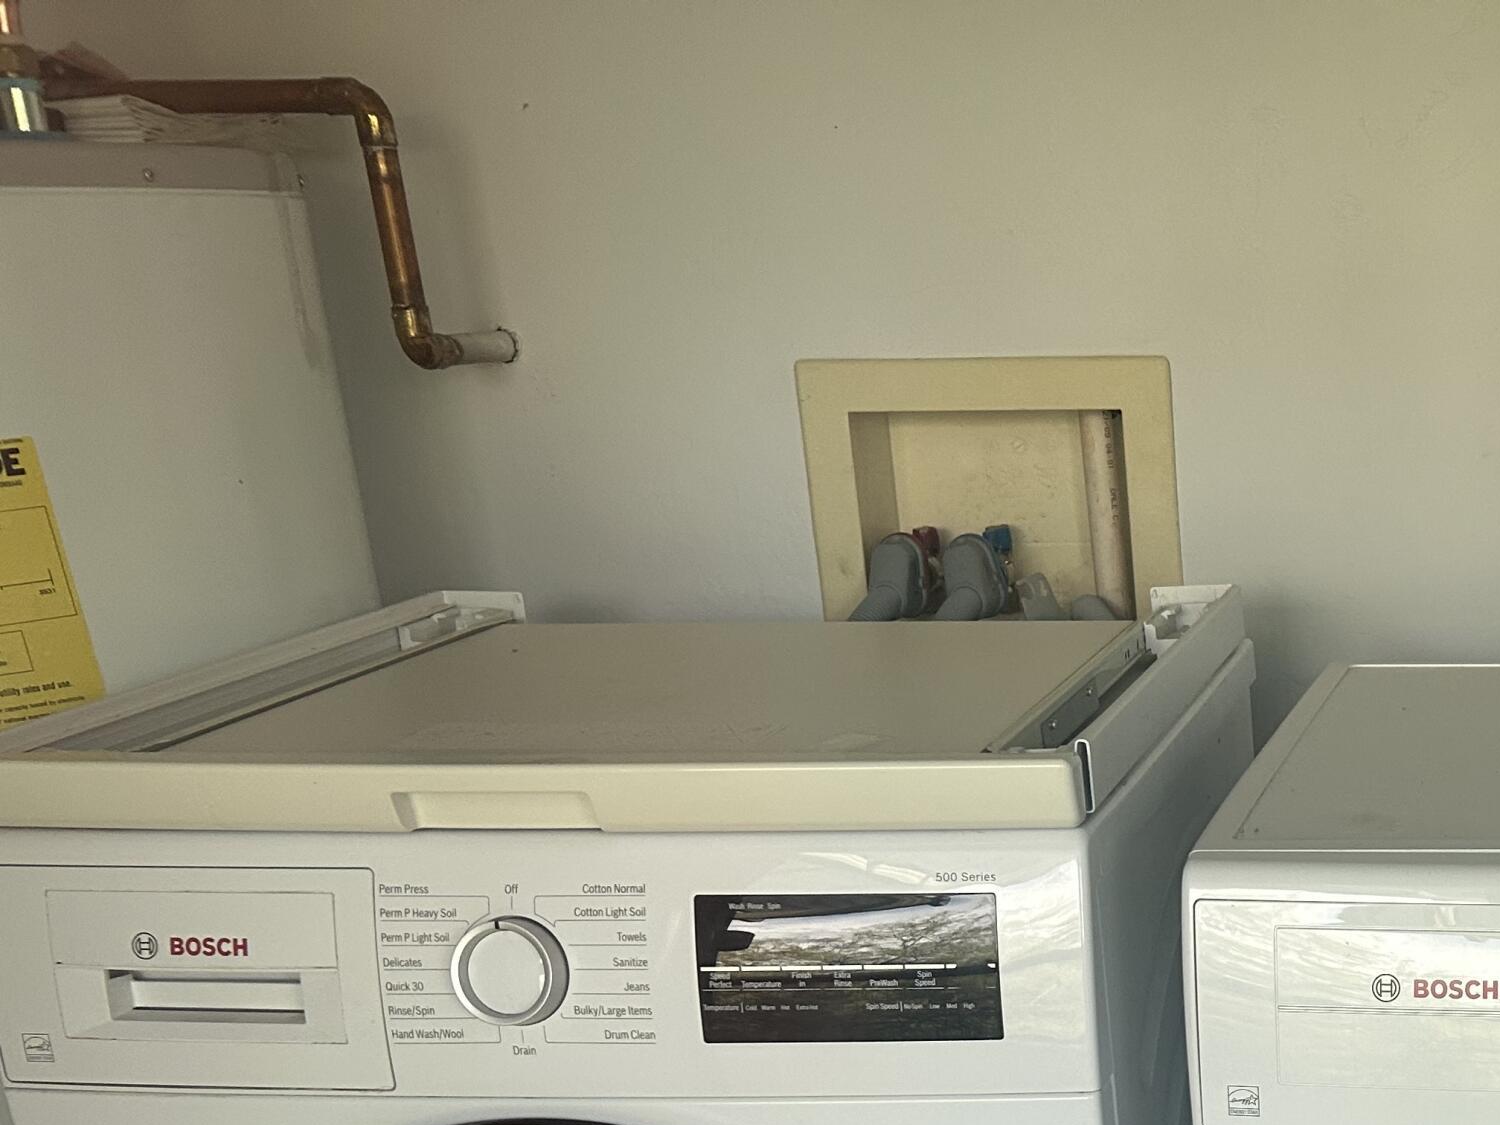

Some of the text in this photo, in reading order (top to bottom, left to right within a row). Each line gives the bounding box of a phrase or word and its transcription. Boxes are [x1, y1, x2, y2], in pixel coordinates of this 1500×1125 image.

[0, 447, 26, 476] E
[936, 872, 996, 882] 500 Series
[379, 884, 428, 894] Perm Press
[504, 884, 518, 894] Off
[582, 884, 646, 894] Cotton Normal
[380, 908, 456, 920] Perm P Heavy Soil
[574, 908, 646, 919] Cotton Light Soil
[381, 933, 449, 944] Perm P Light Soil
[617, 932, 646, 942] Towels
[169, 937, 249, 956] BOSCH
[383, 958, 422, 968] Delicates
[613, 958, 648, 967] Sanitize
[386, 982, 424, 992] Quick 30
[624, 982, 650, 992] Jeans
[1413, 979, 1499, 1000] BOSCH
[388, 1006, 435, 1017] Rinse/Spin
[574, 1006, 652, 1018] Bulky/Large Items
[392, 1029, 463, 1040] Hand Wash/Wool
[604, 1030, 656, 1039] Drum Clean
[513, 1046, 536, 1056] Drain
